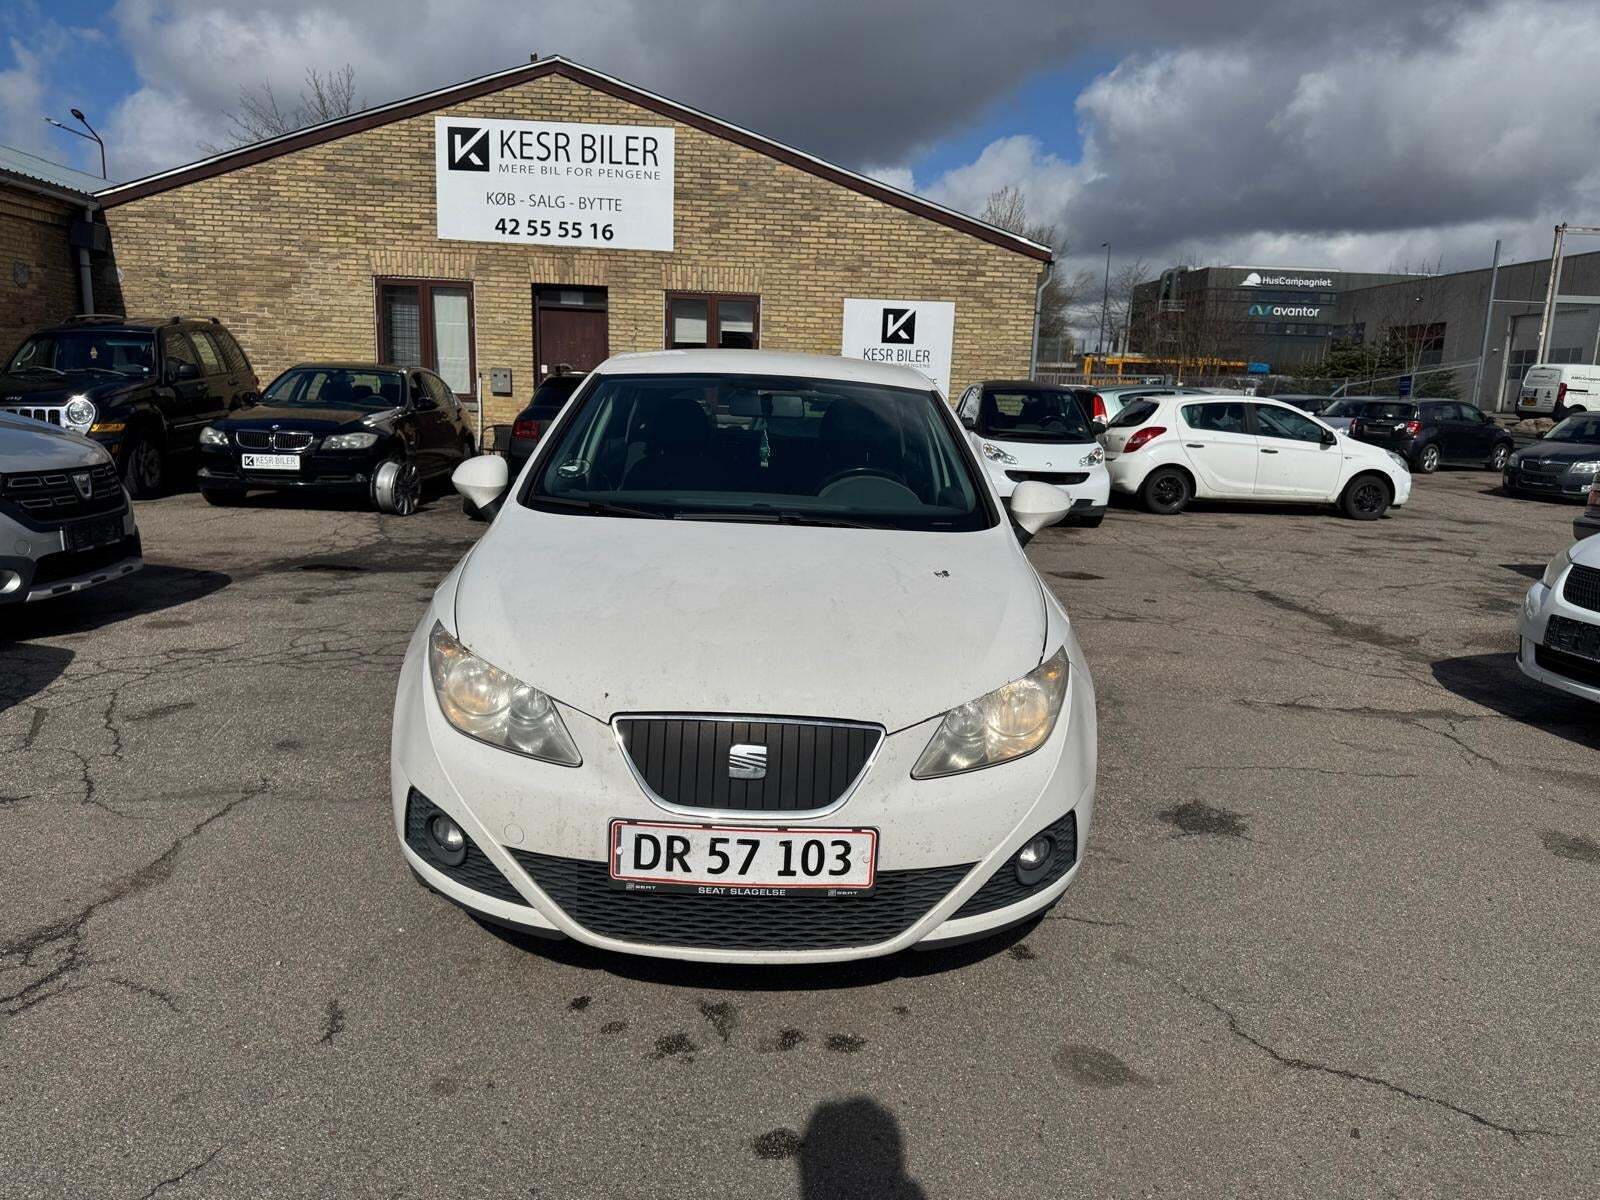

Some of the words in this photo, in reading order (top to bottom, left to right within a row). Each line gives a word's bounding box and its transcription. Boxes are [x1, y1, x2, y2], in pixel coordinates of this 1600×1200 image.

[500, 129, 571, 162] KESR
[581, 133, 659, 167] BILER
[498, 163, 535, 174] MERE
[540, 165, 560, 176] BIL
[566, 166, 593, 177] FOR
[598, 168, 661, 180] PENGENE
[486, 191, 516, 206] KØB
[528, 193, 566, 209] SALG
[578, 196, 622, 212] BYTTE
[495, 217, 521, 236] 42
[526, 219, 552, 237] 55
[558, 221, 583, 239] 55
[590, 222, 614, 241] 16
[1262, 276, 1333, 288] HusCompagniet
[1272, 306, 1320, 317] avantor
[863, 347, 894, 361] KESR
[896, 349, 931, 363] BILER
[633, 833, 692, 873] DR
[707, 837, 761, 875] 57
[777, 839, 852, 877] 103
[698, 886, 726, 895] SEAT
[730, 887, 786, 896] SLAGELSE
